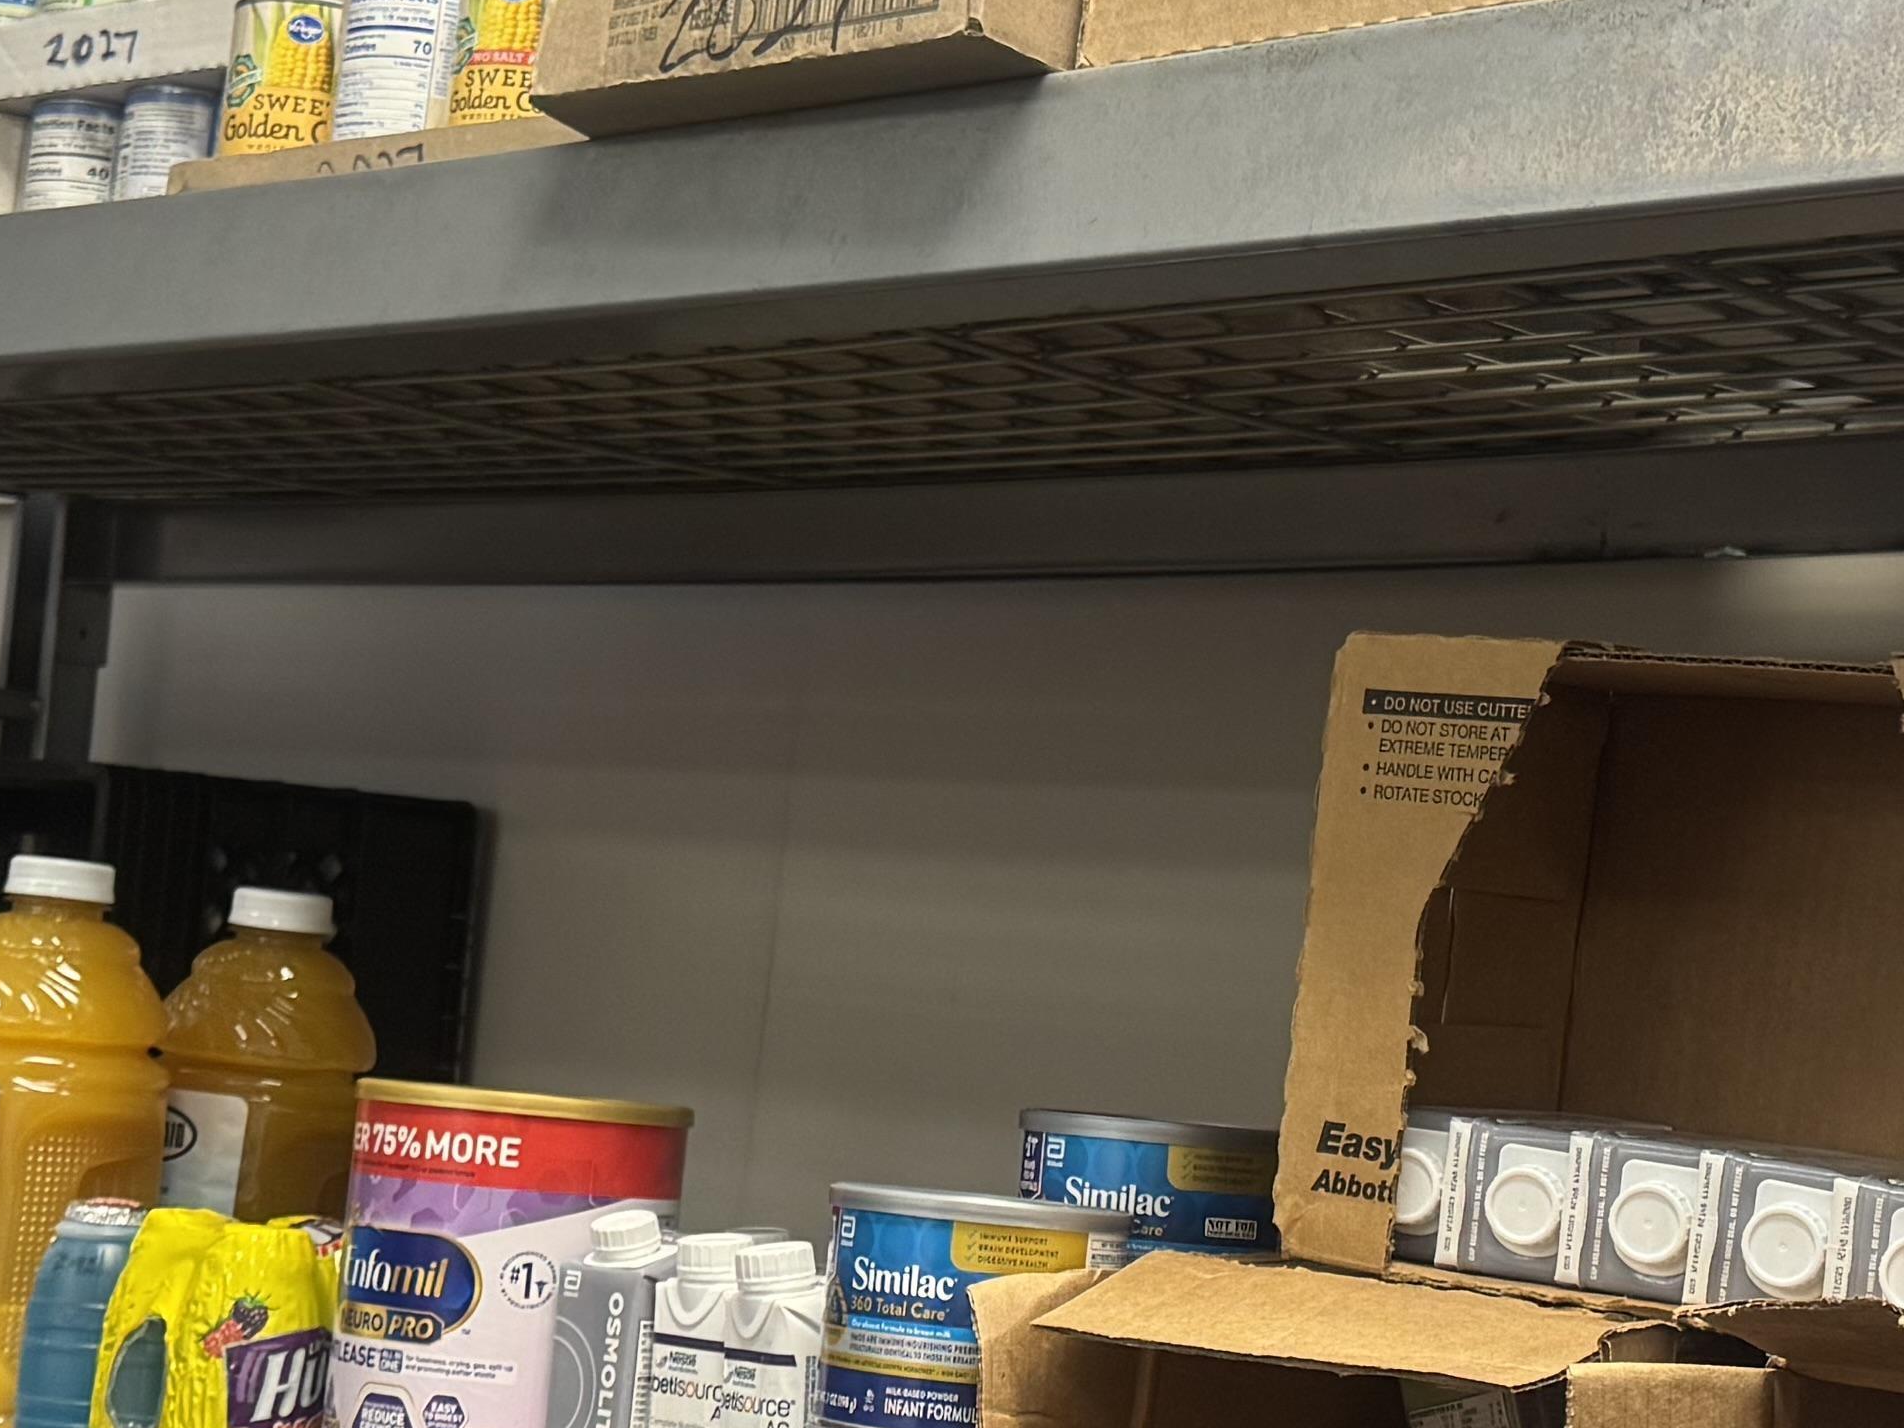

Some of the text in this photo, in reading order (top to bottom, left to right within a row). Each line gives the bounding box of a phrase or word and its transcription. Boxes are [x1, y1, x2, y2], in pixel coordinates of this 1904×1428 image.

[45, 29, 138, 68] 2027
[1381, 719, 1511, 742] DO NOT STORE AT
[372, 1124, 522, 1169] 75% MORE
[1316, 1121, 1398, 1170] Easy
[851, 1256, 954, 1301] Similac
[850, 1294, 945, 1321] 360 Total Care
[389, 1318, 434, 1340] PRO
